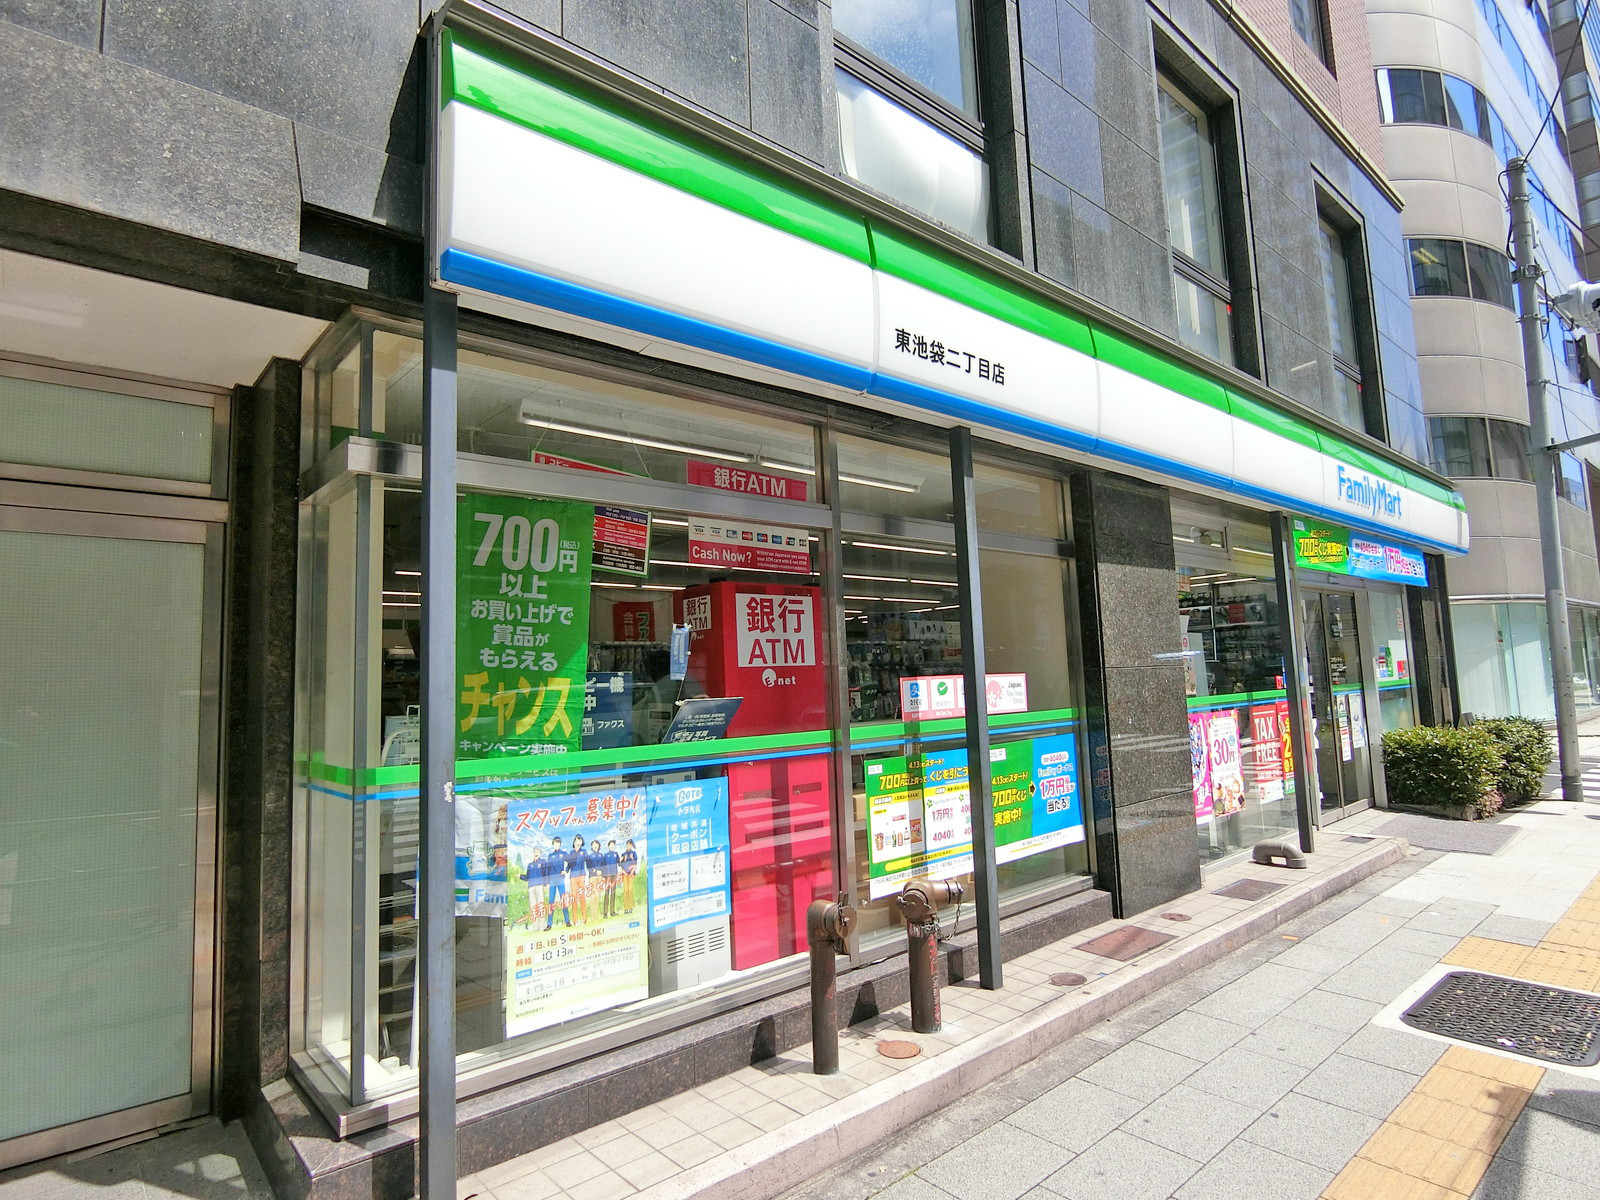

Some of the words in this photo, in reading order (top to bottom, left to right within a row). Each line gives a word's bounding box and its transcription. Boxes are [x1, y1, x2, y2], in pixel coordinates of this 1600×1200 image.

[895, 328, 1005, 386] 東池袋二丁目店
[714, 467, 786, 497] 銀行ATM
[1337, 465, 1402, 516] FamilyMart
[472, 512, 579, 573] 700円
[692, 545, 719, 561] Cash
[722, 548, 752, 563] Now?
[500, 573, 548, 599] 以上
[470, 599, 574, 625] お買い上げで
[686, 597, 708, 616] 銀行
[746, 597, 805, 634] 銀行
[492, 624, 550, 647] 賞品が
[480, 647, 558, 672] もらえる
[748, 638, 806, 665] ATM
[461, 671, 573, 739] チャンス
[597, 719, 625, 729] ファクス
[1254, 715, 1275, 741] TAX
[459, 739, 568, 755] キャンペーン実施中
[1255, 741, 1279, 763] FREE
[516, 794, 640, 832] スタッフさん募集中!
[678, 804, 701, 816] トラベル
[932, 807, 954, 820] 1万円
[994, 807, 1022, 827] 実施中!
[1047, 797, 1070, 814] 当たる!
[671, 828, 708, 843] クーポン
